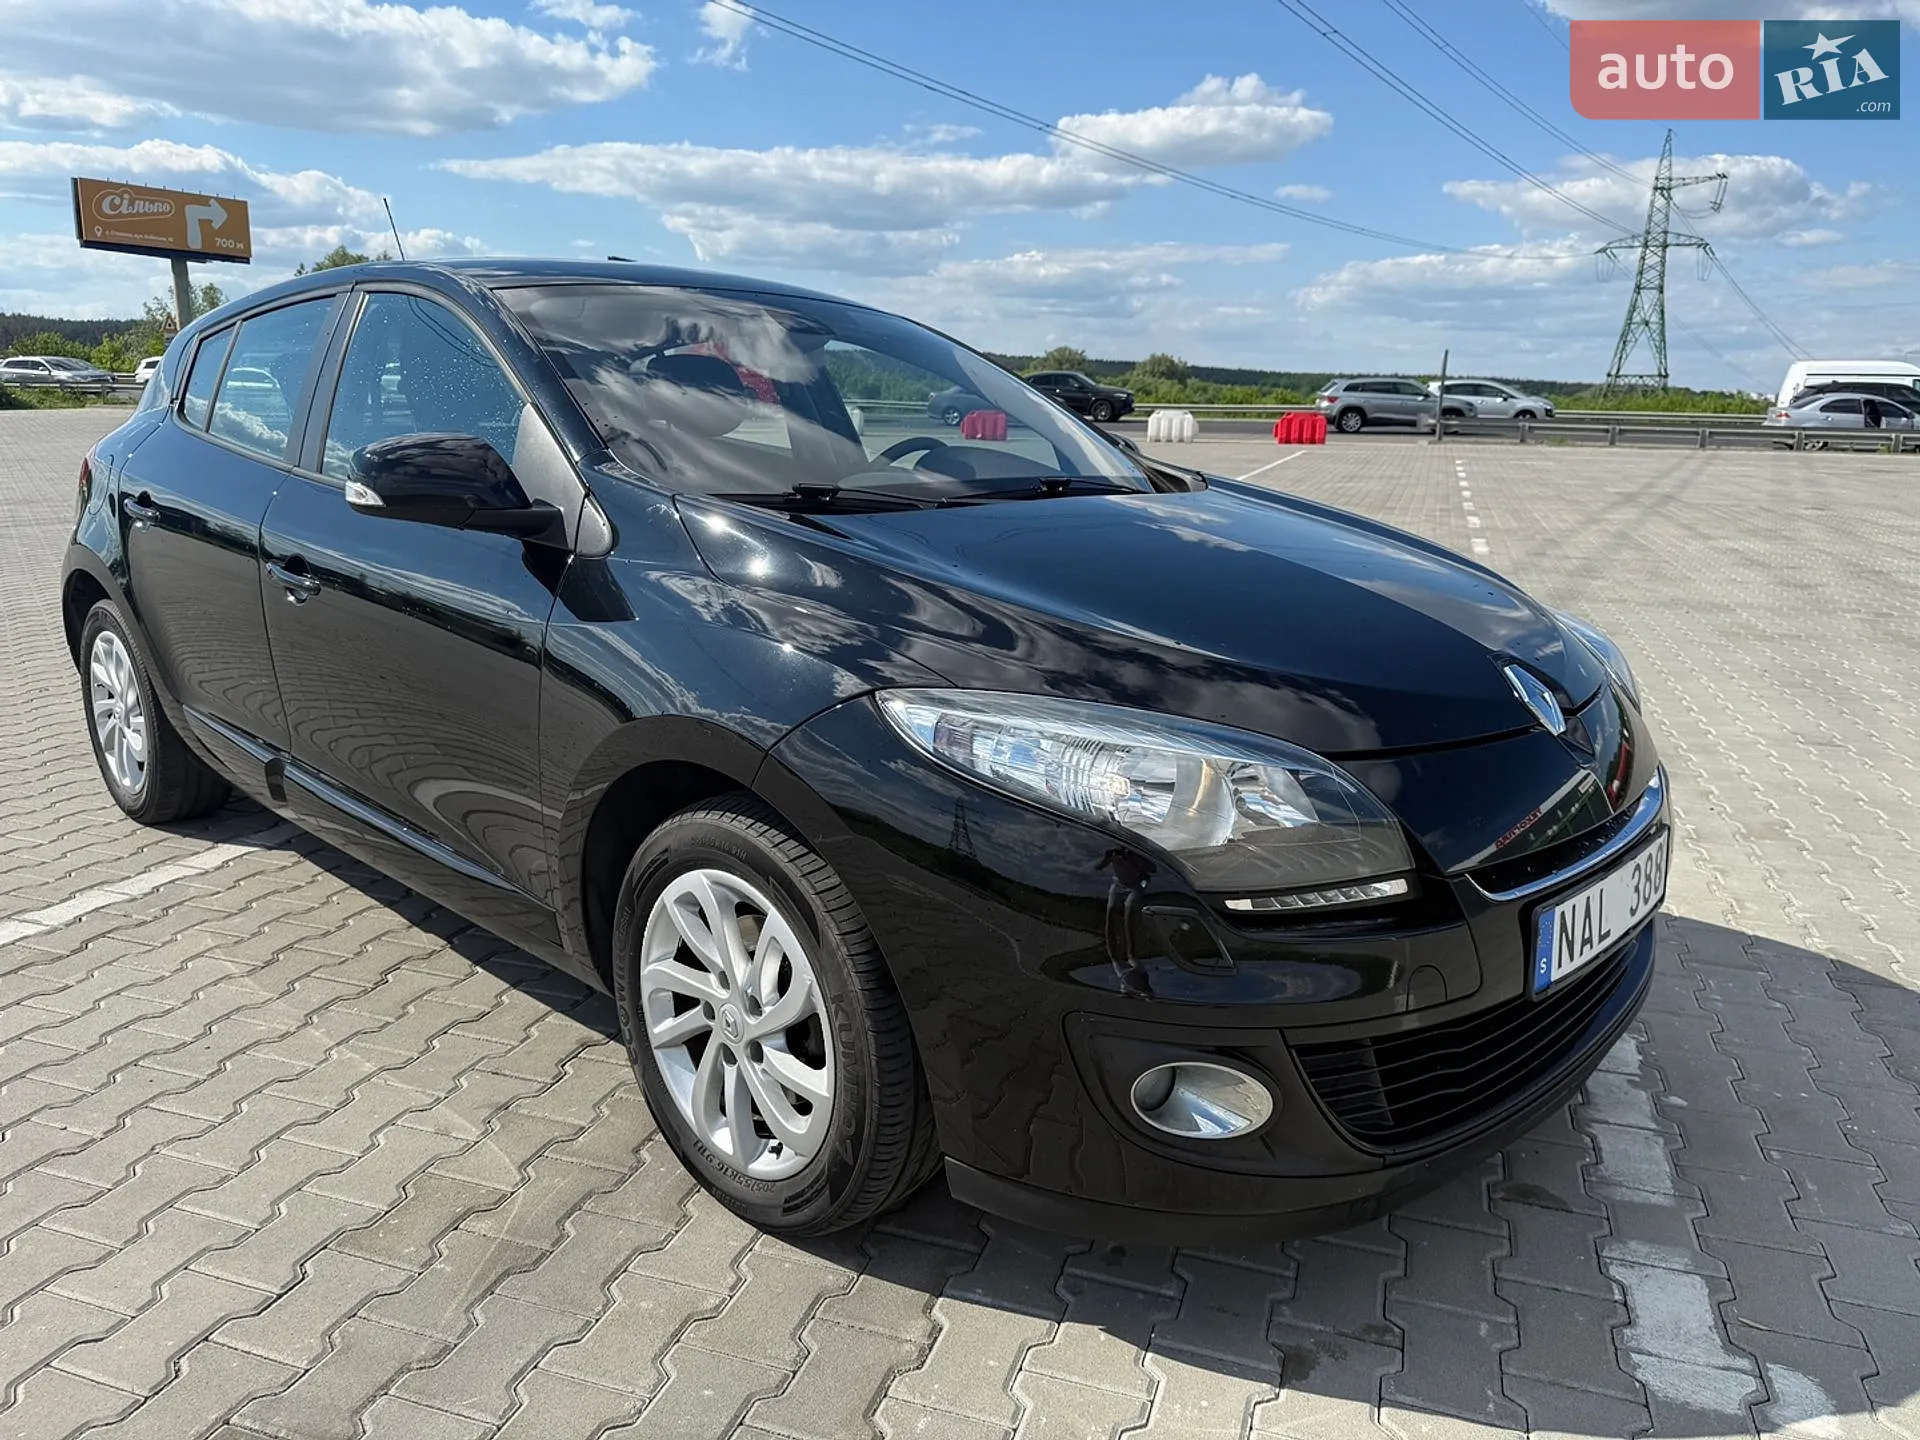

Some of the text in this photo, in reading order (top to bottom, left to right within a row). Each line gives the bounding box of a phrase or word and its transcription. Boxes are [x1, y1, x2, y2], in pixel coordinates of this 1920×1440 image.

[102, 193, 170, 215] Сільпо
[214, 237, 235, 249] 700
[1557, 844, 1663, 969] NAL 388
[1539, 958, 1547, 976] S
[831, 994, 859, 1136] KUMHO
